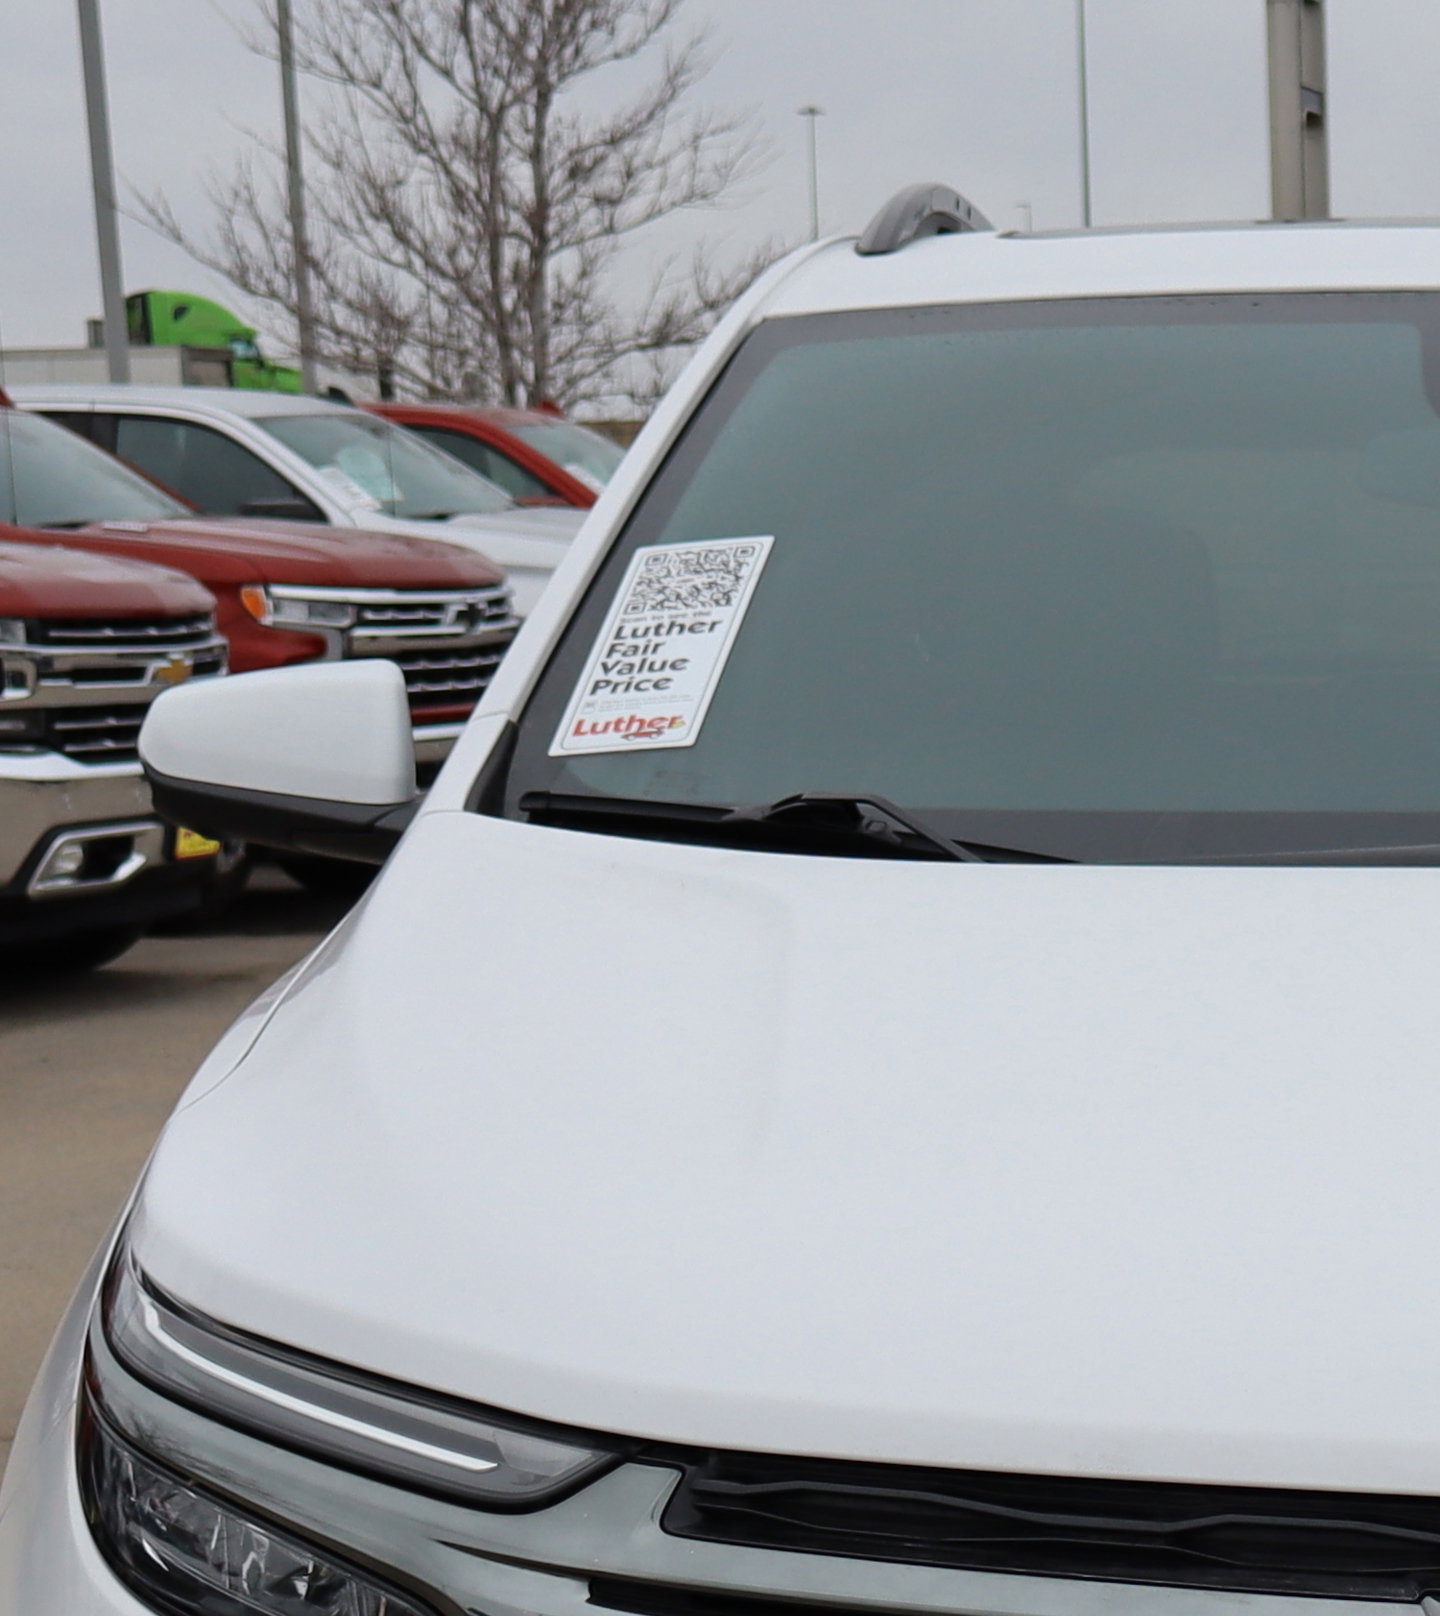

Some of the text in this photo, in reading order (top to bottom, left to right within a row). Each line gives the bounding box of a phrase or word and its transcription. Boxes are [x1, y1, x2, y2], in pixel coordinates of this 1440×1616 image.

[613, 620, 723, 640] Luther
[605, 639, 666, 659] Fair
[600, 657, 690, 676] Value
[589, 676, 673, 696] Price
[572, 714, 684, 735] Luther
